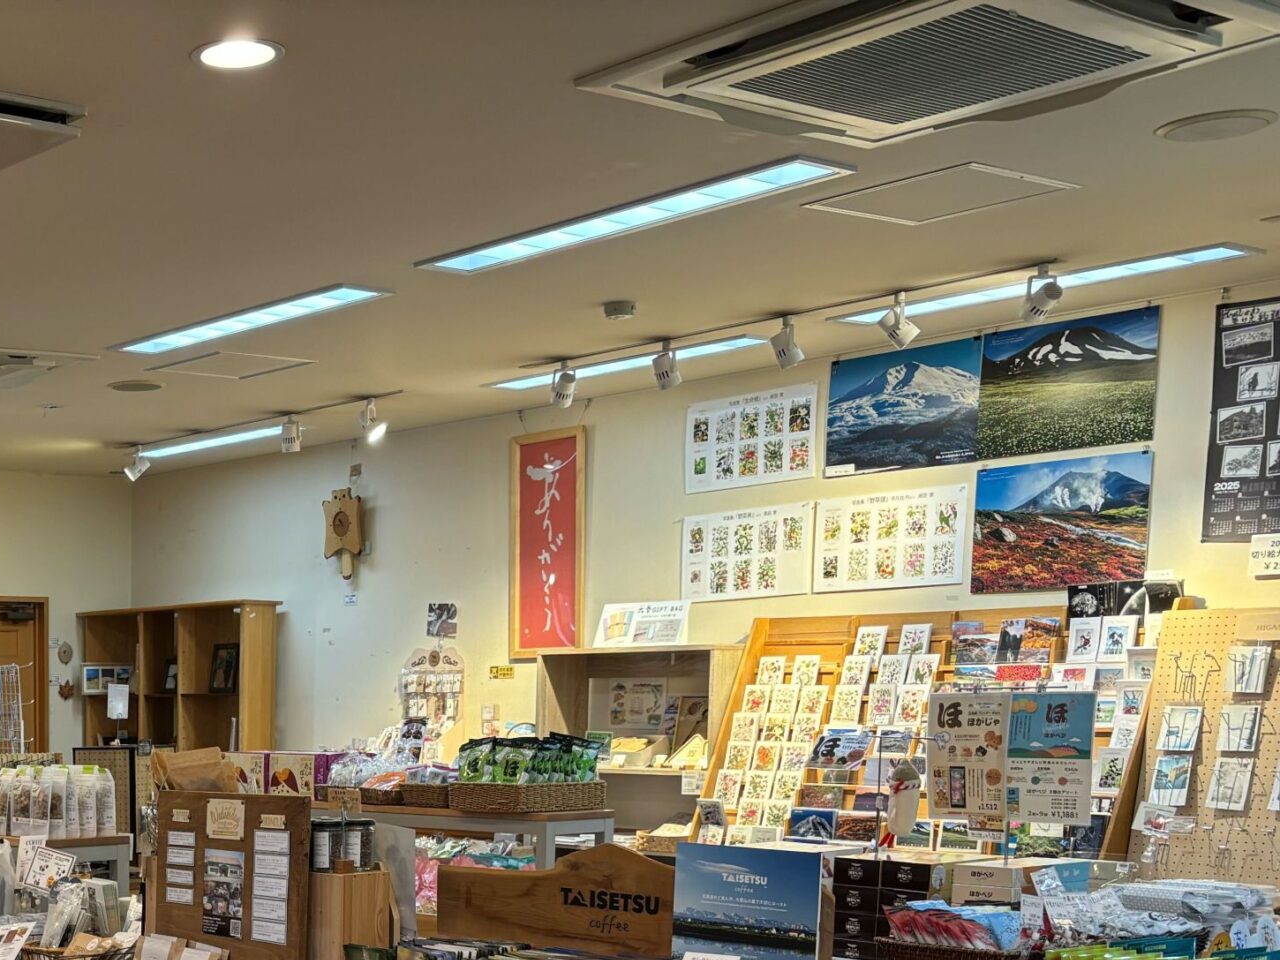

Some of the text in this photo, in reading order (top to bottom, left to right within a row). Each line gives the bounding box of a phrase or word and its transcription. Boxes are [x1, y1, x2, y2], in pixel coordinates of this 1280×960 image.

[1214, 481, 1240, 491] 2025
[937, 701, 963, 729] ほ
[1046, 702, 1069, 724] ほ
[722, 872, 768, 886] TAISETSU
[734, 885, 754, 894] coffee
[560, 887, 660, 915] TAISETSU
[589, 915, 630, 934] coffee
